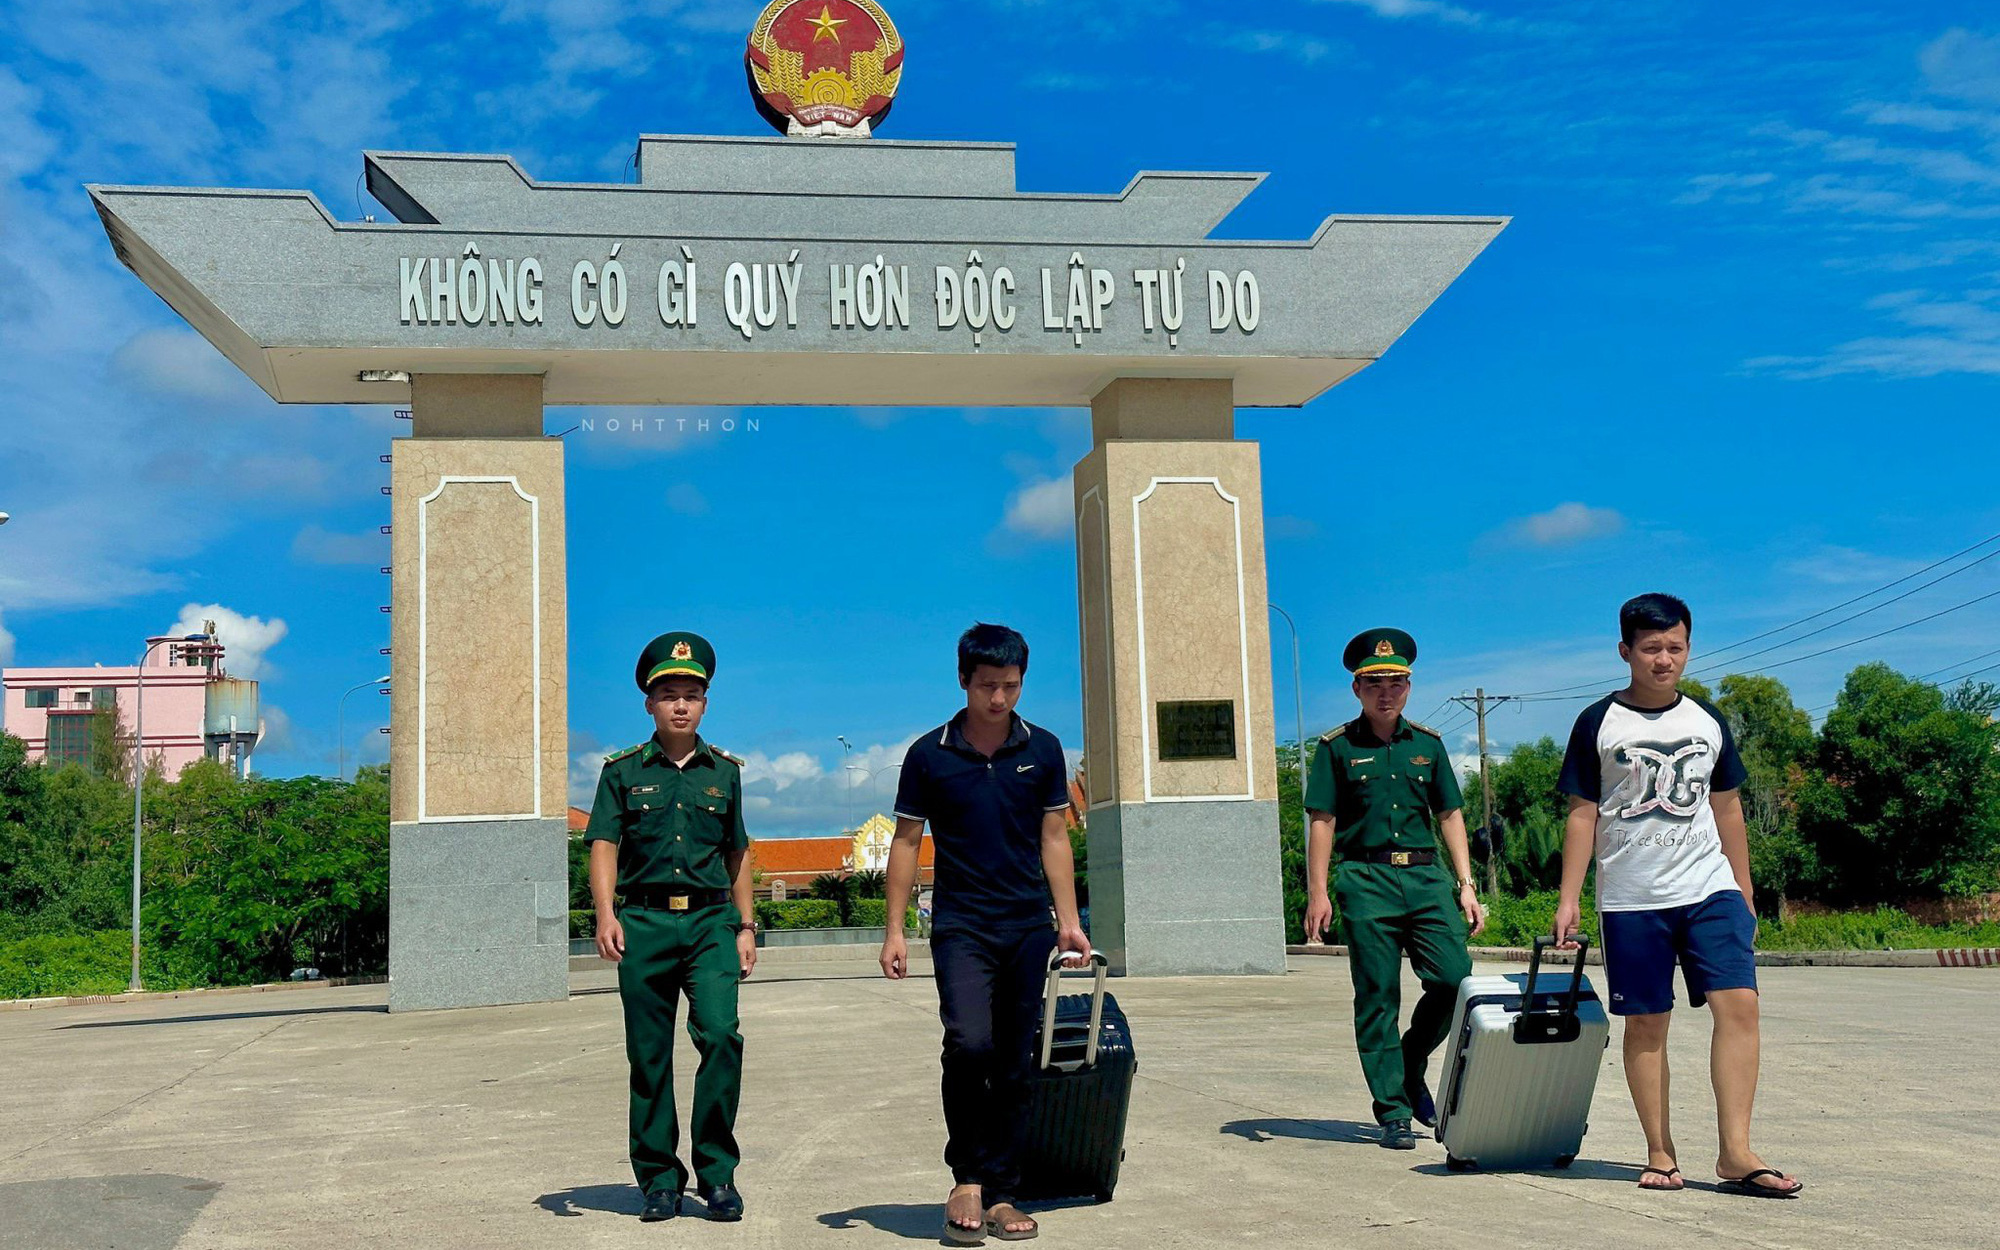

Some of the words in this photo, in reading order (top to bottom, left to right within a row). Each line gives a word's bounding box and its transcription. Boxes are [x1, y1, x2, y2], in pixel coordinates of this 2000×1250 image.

[400, 241, 544, 326] KHÔNG
[571, 243, 628, 327] CÓ
[657, 245, 697, 328] GÌ
[724, 249, 803, 340] QUÝ
[830, 254, 910, 327] HƠN
[935, 250, 1016, 346] ĐỘC
[1041, 251, 1115, 347] LẬP
[1134, 257, 1186, 348] TỰ
[1208, 269, 1260, 332] DO
